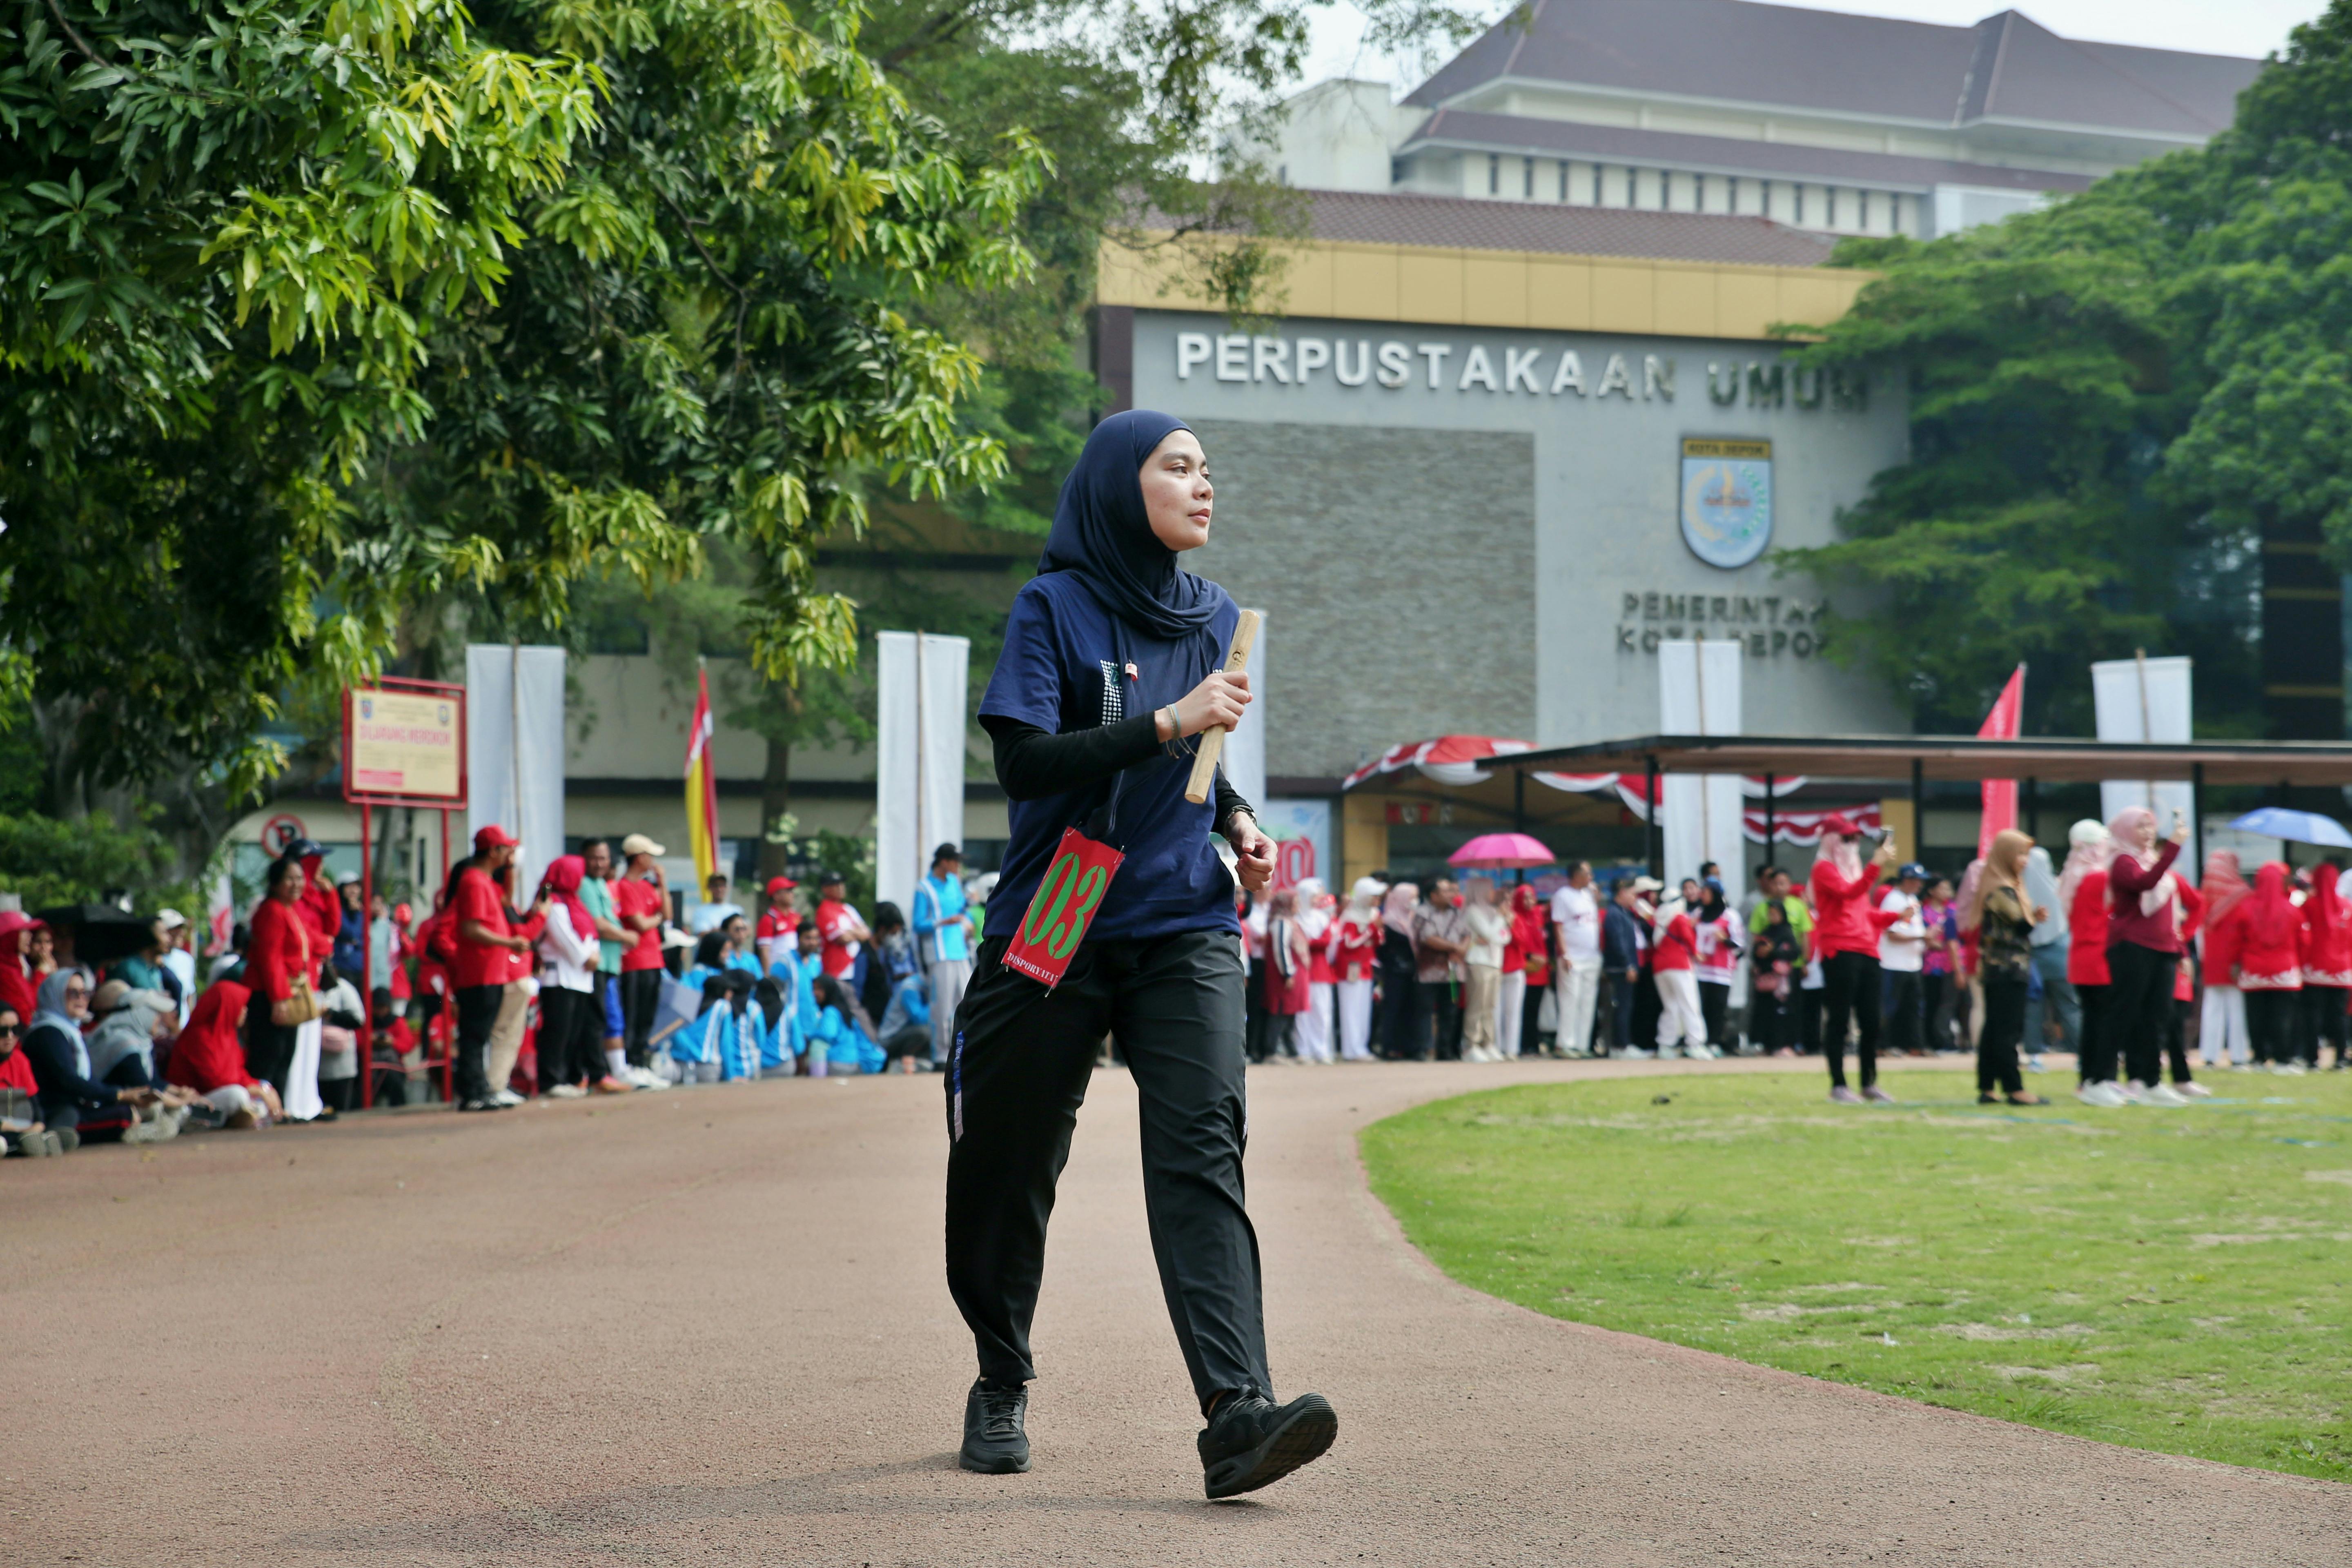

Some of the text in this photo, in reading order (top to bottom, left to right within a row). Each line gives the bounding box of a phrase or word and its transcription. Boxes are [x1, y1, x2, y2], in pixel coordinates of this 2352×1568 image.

[1177, 332, 1676, 402] PERPUSTAKAAN
[1024, 852, 1107, 960] 03
[1007, 952, 1055, 982] DISPORYATA
